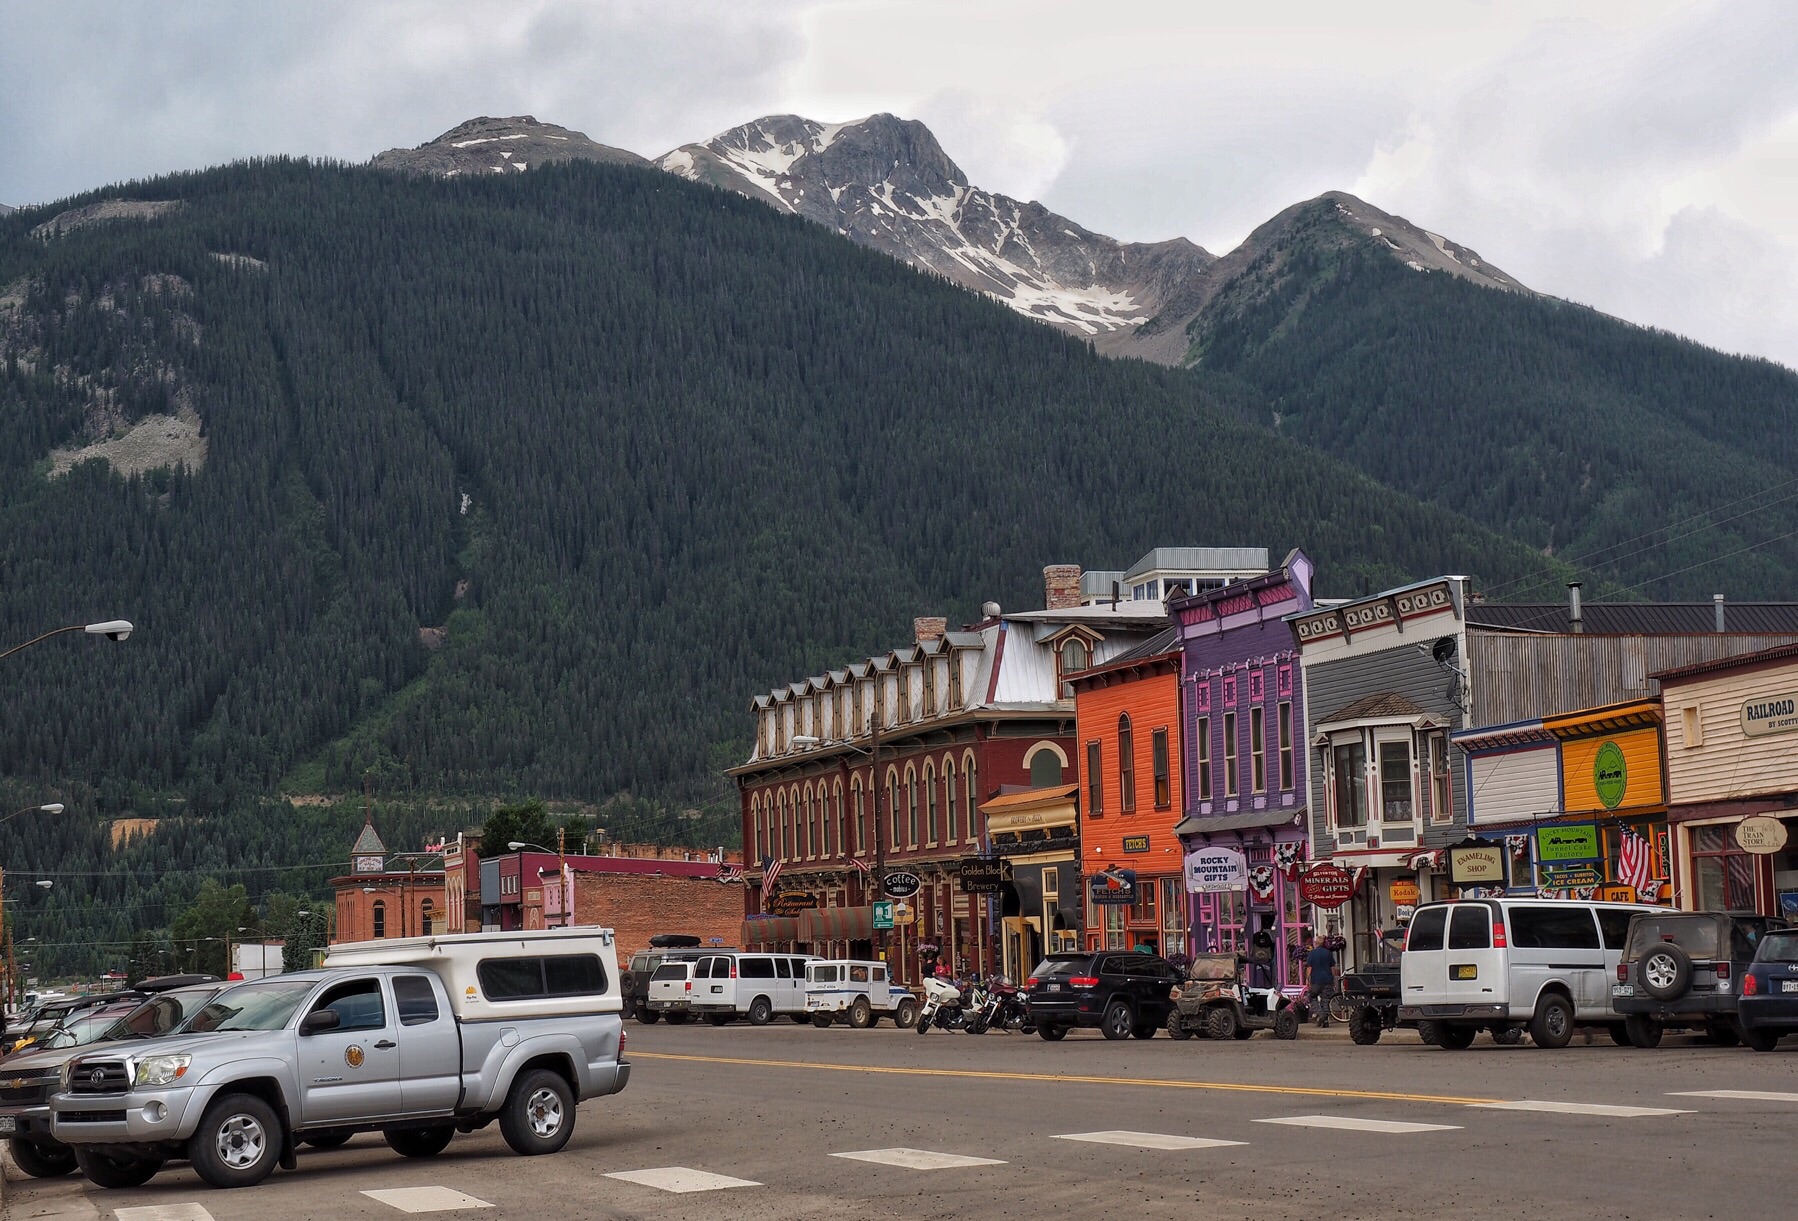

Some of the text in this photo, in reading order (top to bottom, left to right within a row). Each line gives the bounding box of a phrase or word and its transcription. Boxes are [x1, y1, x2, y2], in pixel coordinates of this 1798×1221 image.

[1747, 700, 1794, 721] RAILROAD
[1542, 828, 1592, 840] ROCKY MOUNTAIN
[1456, 852, 1495, 865] ENAMELING
[1660, 836, 1669, 876] OPEN
[961, 865, 984, 876] Golden
[1194, 865, 1237, 873] MOUNTAIN
[886, 875, 916, 885] coffee
[967, 881, 998, 891] Brewery
[1611, 892, 1629, 901] CAFE
[773, 898, 814, 907] Restaurant
